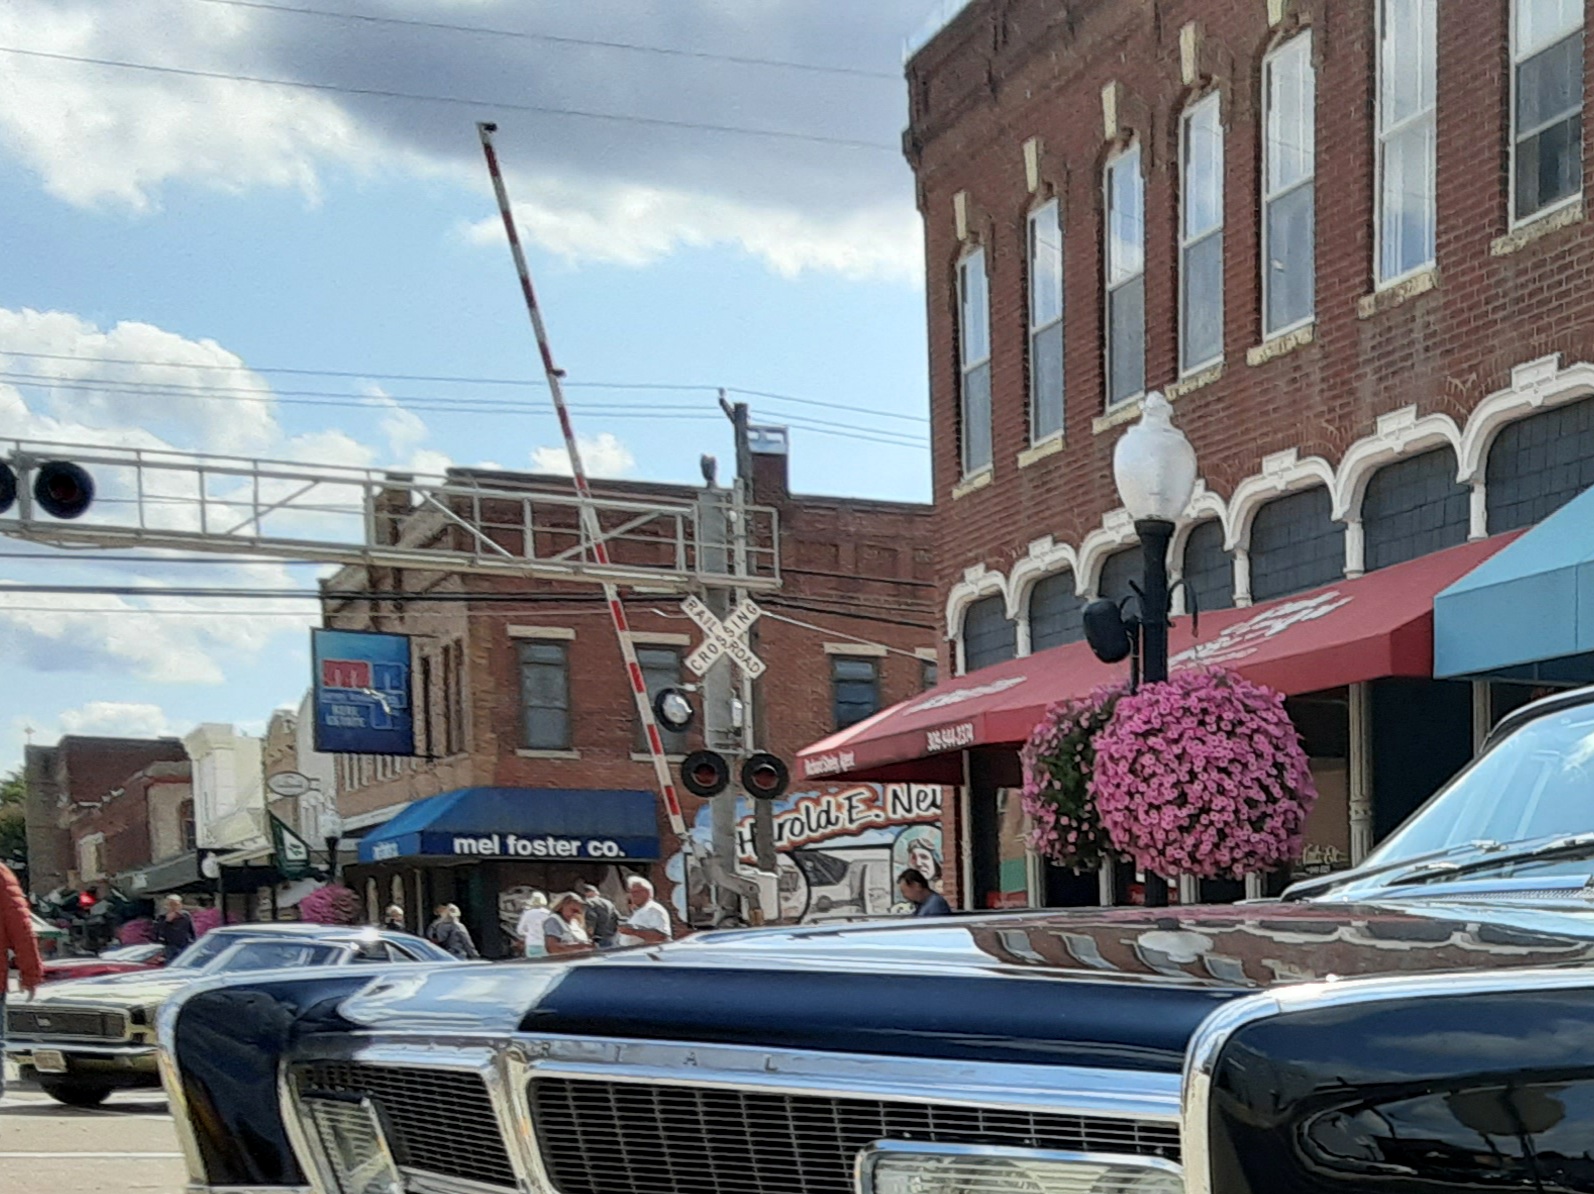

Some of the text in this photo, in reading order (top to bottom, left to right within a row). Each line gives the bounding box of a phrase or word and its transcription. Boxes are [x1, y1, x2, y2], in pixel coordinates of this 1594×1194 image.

[738, 799, 840, 854] Hrold
[842, 791, 884, 823] E.
[453, 834, 626, 858] mel foster co.
